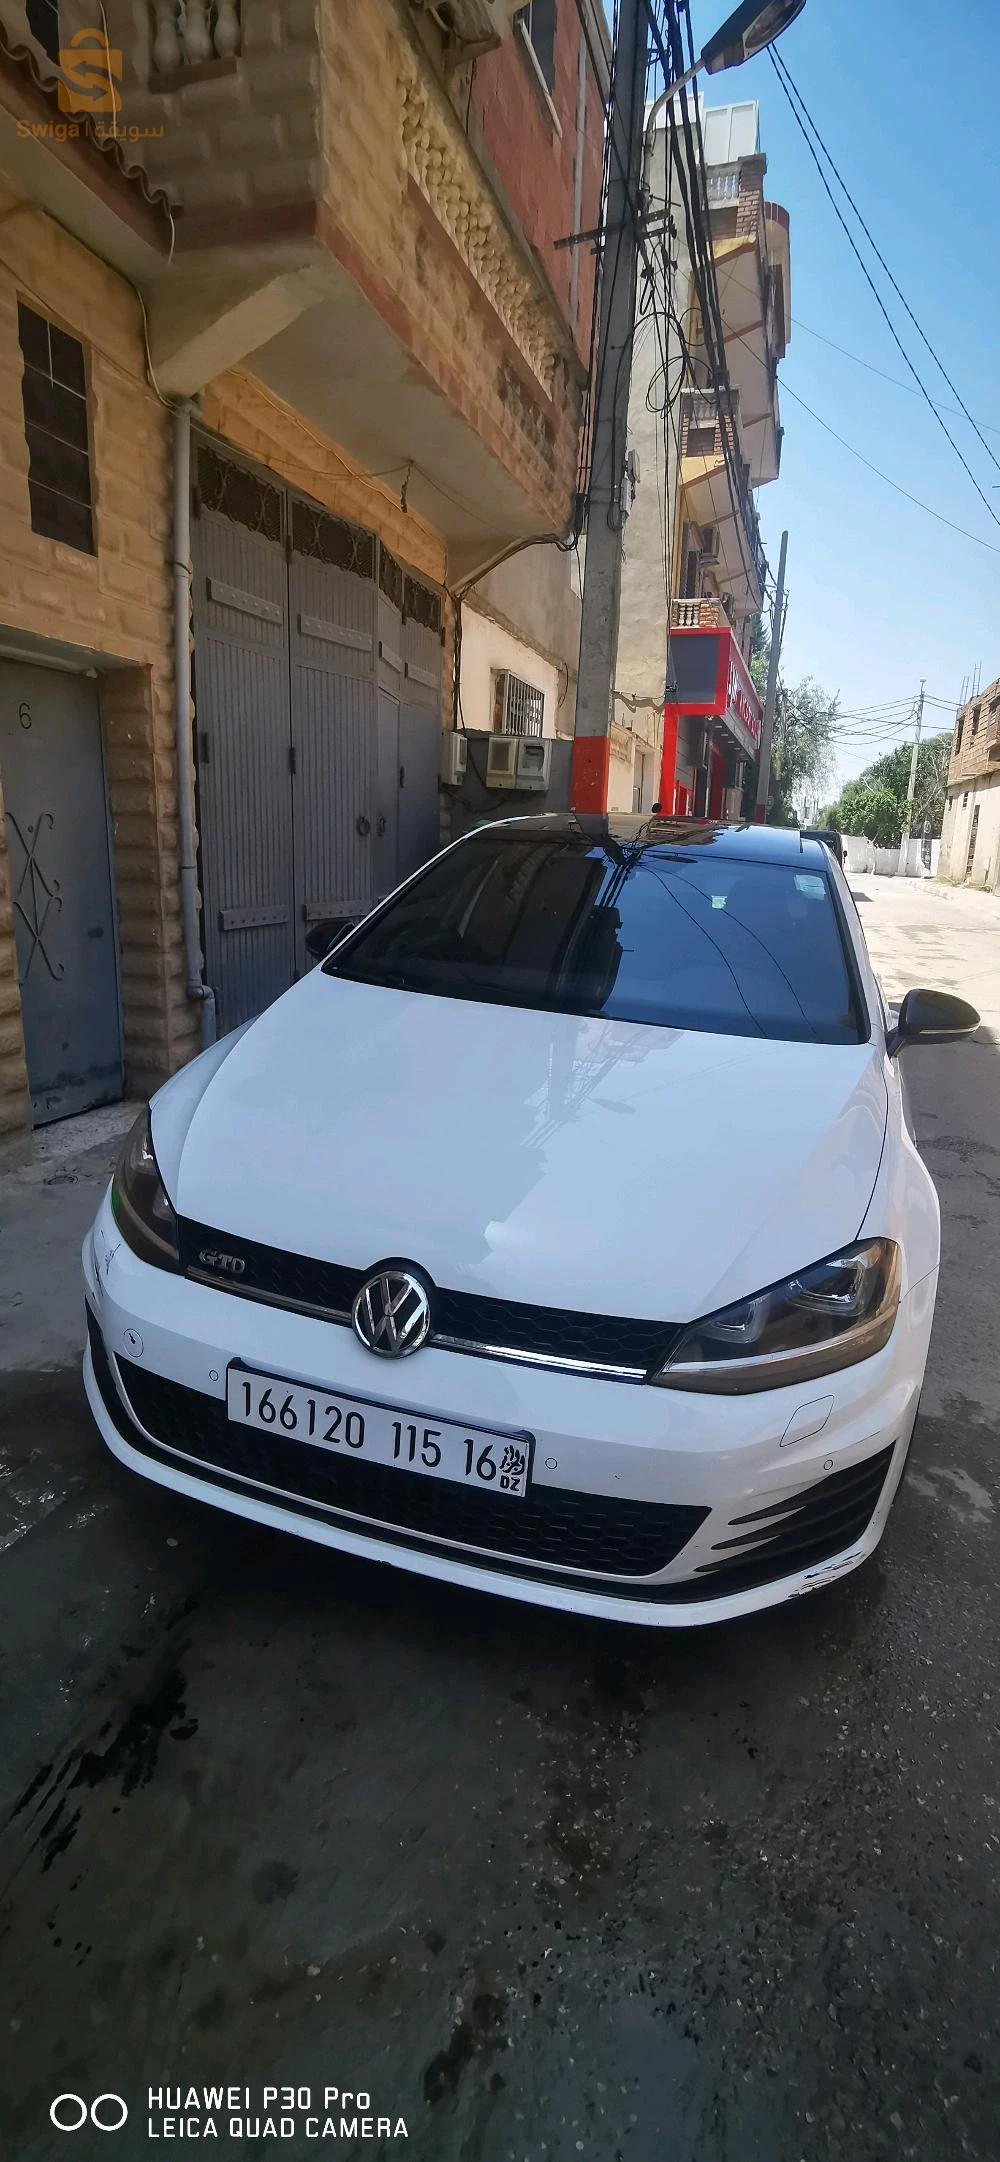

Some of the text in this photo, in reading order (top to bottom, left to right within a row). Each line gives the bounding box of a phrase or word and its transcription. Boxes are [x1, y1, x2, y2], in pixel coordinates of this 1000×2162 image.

[19, 702, 32, 729] 6
[199, 1249, 246, 1273] GTD
[242, 1381, 366, 1449] 166120
[391, 1421, 442, 1468] 115
[463, 1438, 497, 1481] 16
[499, 1475, 521, 1492] DZ
